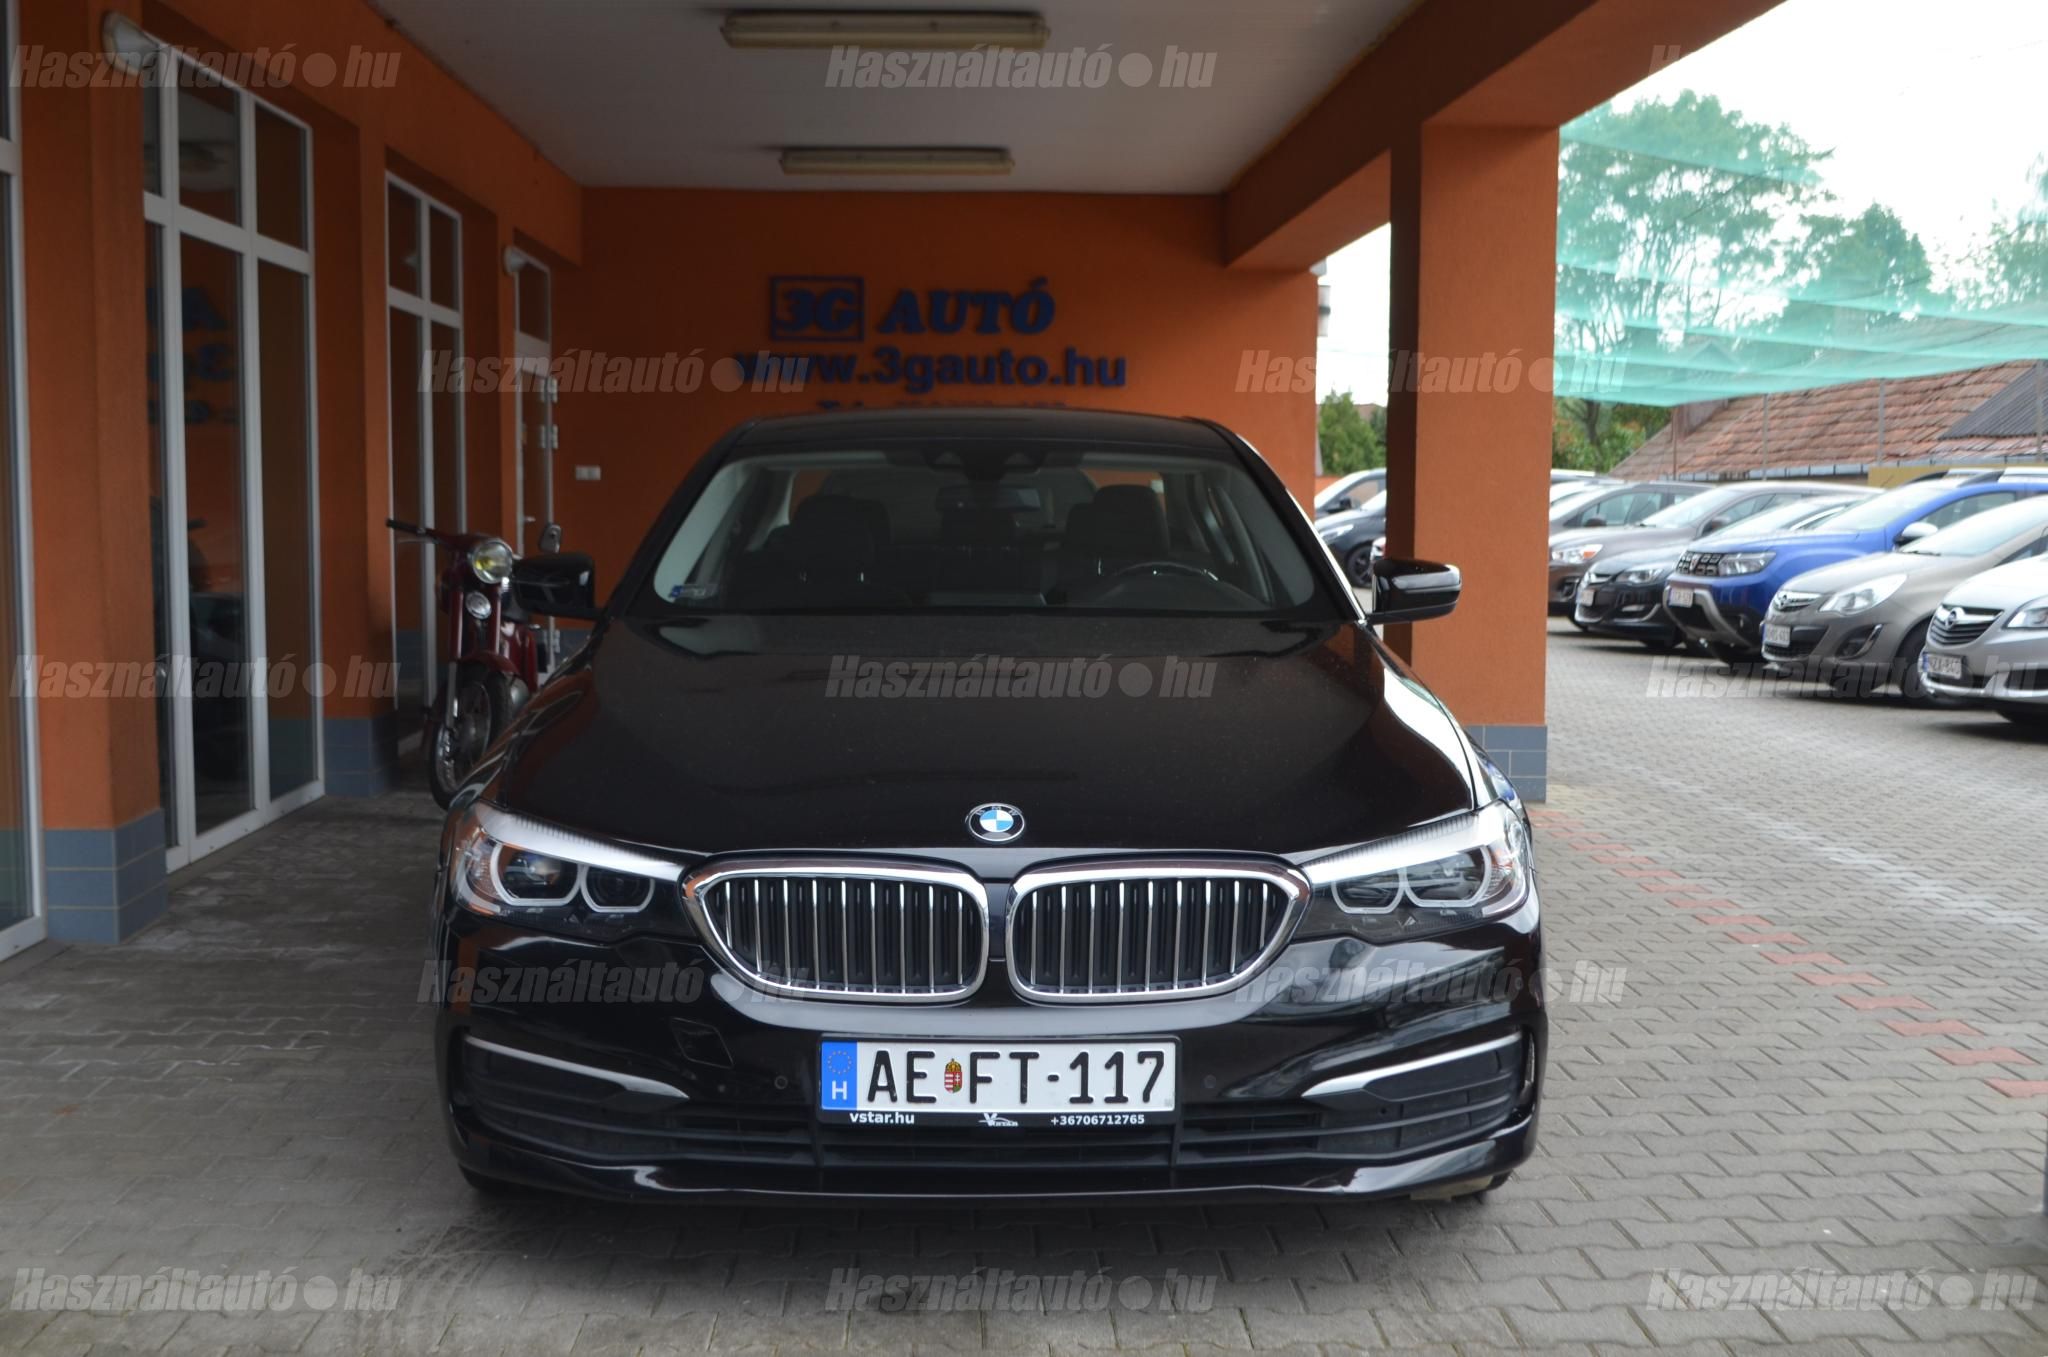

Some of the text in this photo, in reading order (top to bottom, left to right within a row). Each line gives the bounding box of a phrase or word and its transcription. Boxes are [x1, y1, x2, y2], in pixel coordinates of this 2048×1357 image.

[780, 277, 1056, 335] 3G AUTÓ
[734, 346, 1127, 395] www.3gauto.hu
[832, 1080, 848, 1101] H
[868, 1050, 1165, 1104] AE FT-117
[849, 1112, 915, 1125] vstar.hu
[1050, 1114, 1145, 1126] +36706712765
